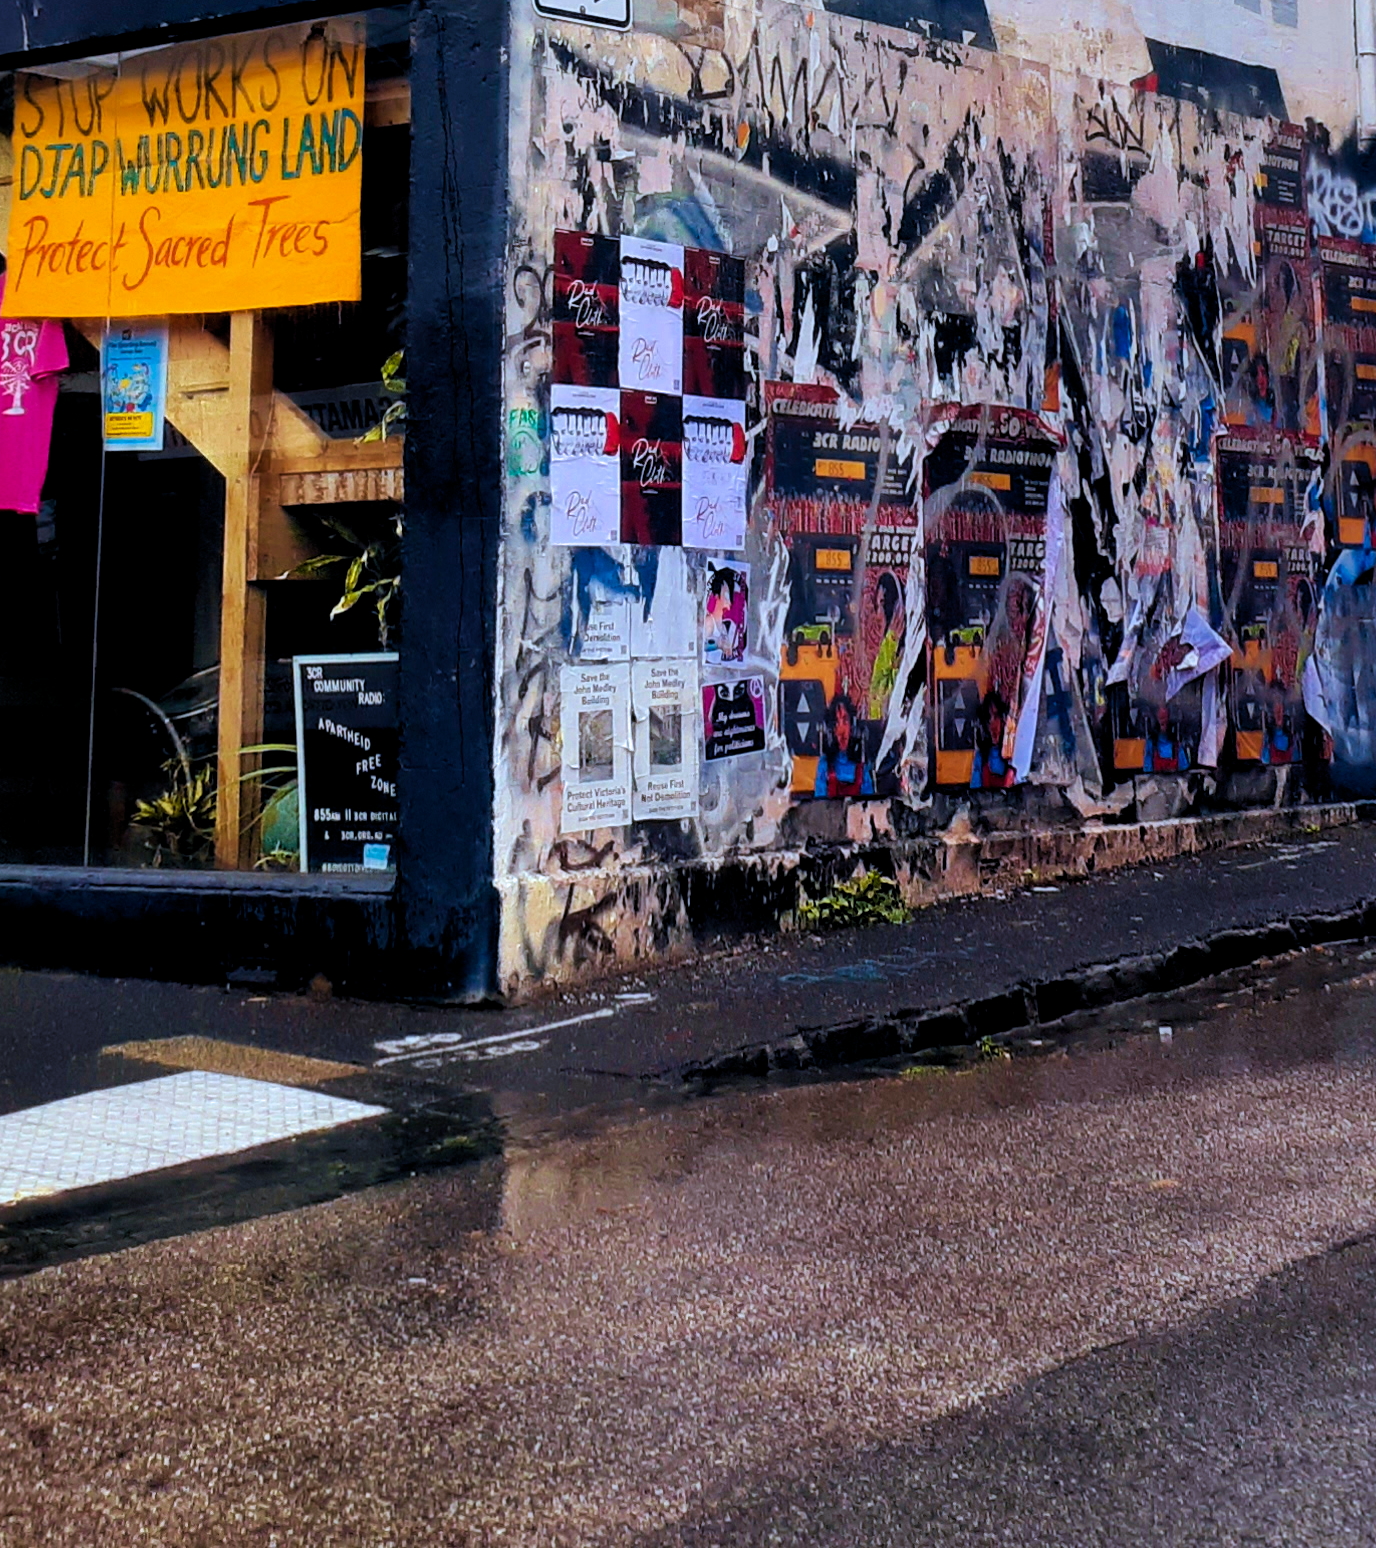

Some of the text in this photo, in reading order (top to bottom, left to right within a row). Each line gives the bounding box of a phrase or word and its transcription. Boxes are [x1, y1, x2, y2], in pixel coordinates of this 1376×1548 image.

[20, 21, 359, 139] STOP WORKS ON
[19, 107, 363, 201] DJAP WURRUNG LAND
[15, 195, 329, 292] Protect Sacred Trees
[1000, 413, 1020, 437] 50
[813, 432, 838, 449] 3CR
[307, 667, 323, 680] 3CR
[581, 673, 610, 682] Save the
[651, 668, 678, 678] Save the
[314, 679, 365, 693] COMMUNITY
[574, 685, 591, 695] John
[645, 680, 660, 689] John
[582, 695, 609, 705] Building
[652, 690, 678, 700] Building
[318, 717, 371, 751] APARTHEID
[356, 753, 382, 775] FREE
[371, 775, 396, 797] ZONE
[670, 780, 684, 789] First
[567, 789, 592, 800] Protect
[641, 790, 690, 802] Not Demolition
[567, 798, 626, 812] Cultural Heritage
